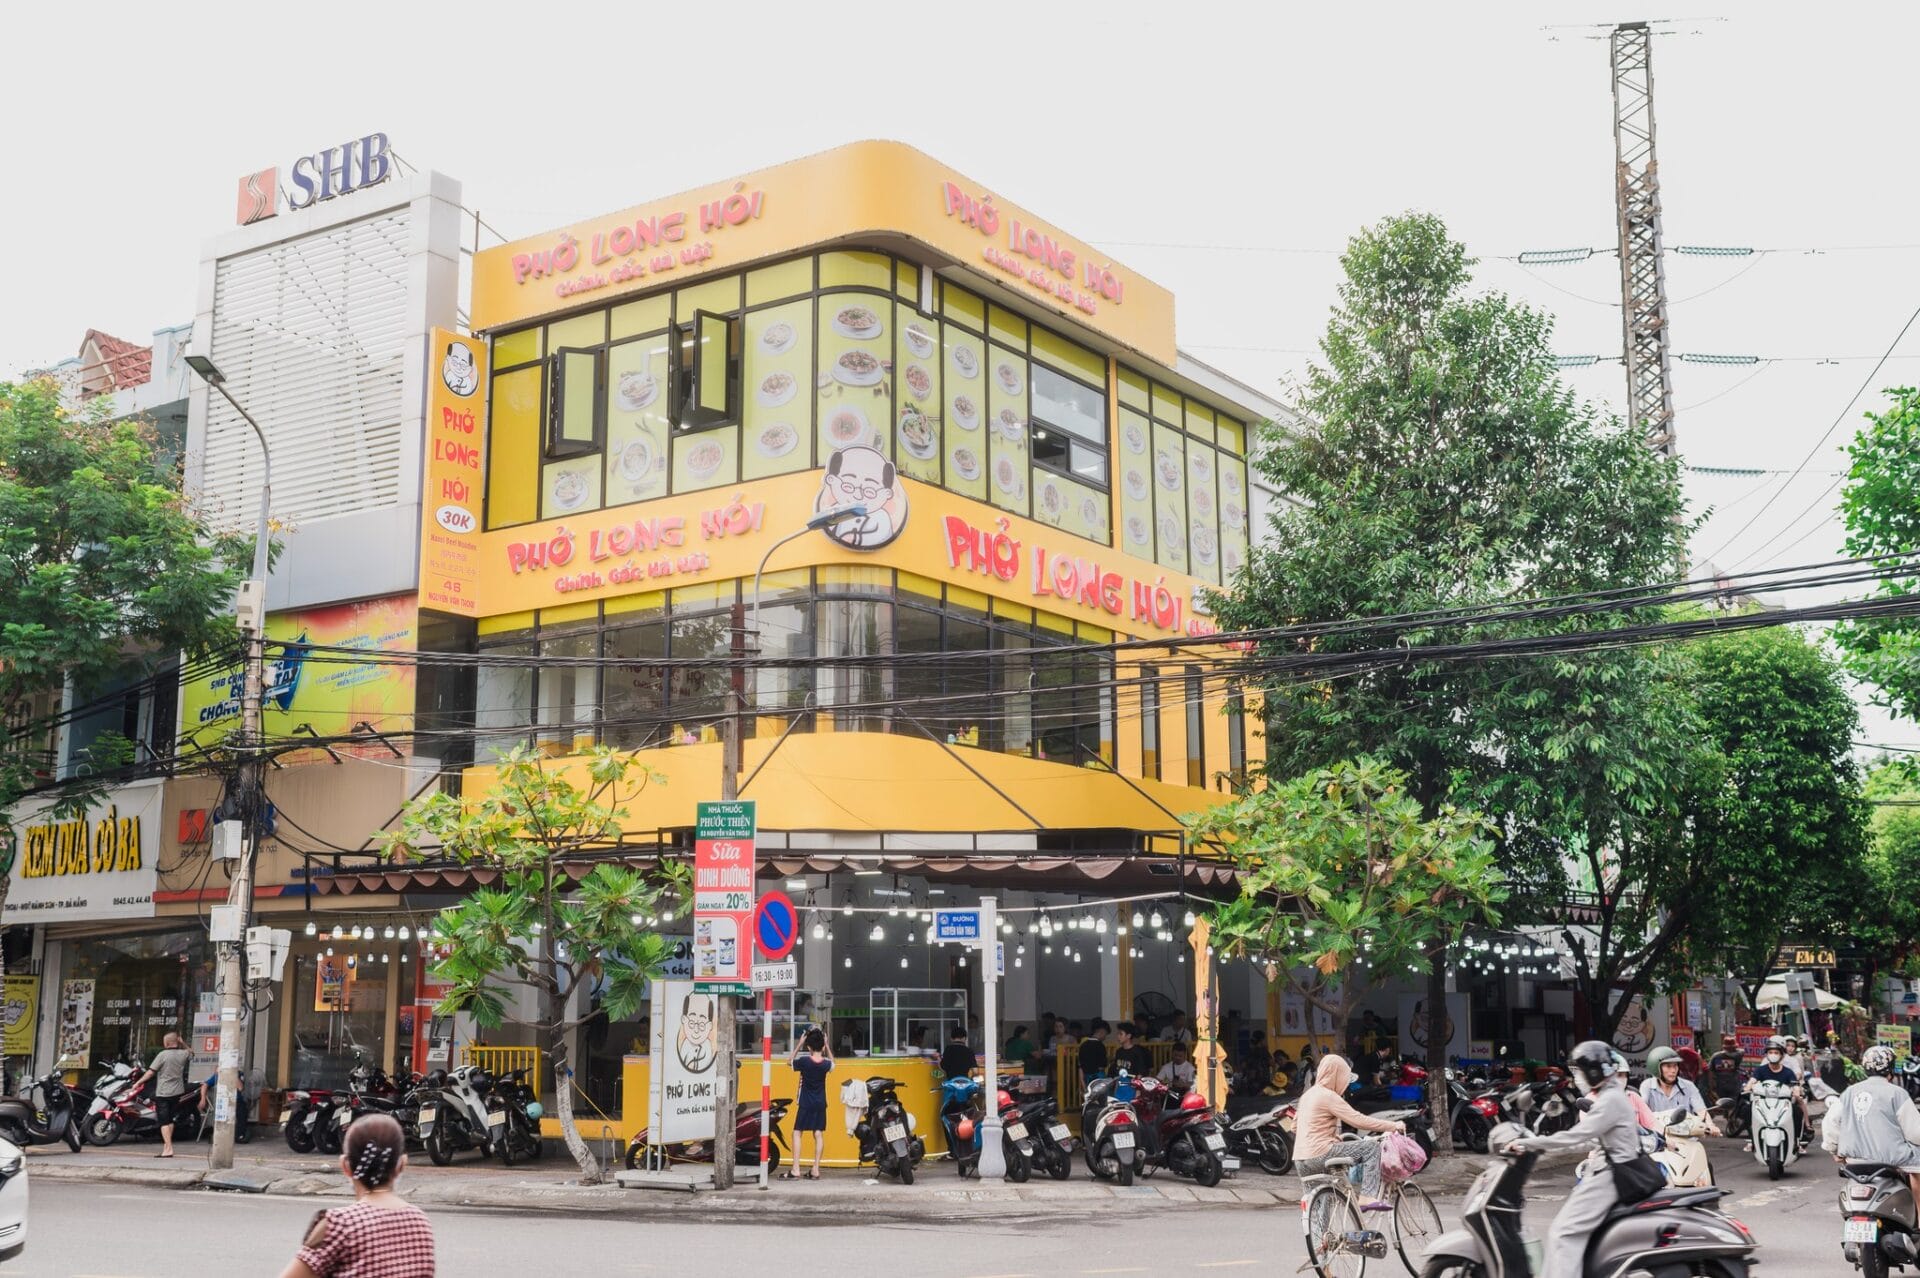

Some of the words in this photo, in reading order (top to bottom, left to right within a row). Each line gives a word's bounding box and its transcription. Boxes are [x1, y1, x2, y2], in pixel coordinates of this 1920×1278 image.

[289, 132, 391, 211] SHB
[943, 181, 999, 237] PHỞ
[1009, 218, 1077, 280] LONG
[512, 232, 578, 285] PHỞ
[591, 211, 687, 266] LONG
[442, 406, 476, 434] PHỞ
[435, 438, 479, 469] LONG
[442, 476, 470, 504] HÓI
[443, 510, 470, 529] 30K
[507, 525, 577, 575] PHỞ
[590, 517, 687, 564] LONG
[942, 515, 1022, 582] PHỞ
[1031, 544, 1124, 616] LONG
[1130, 575, 1183, 633] HÓI
[20, 823, 58, 878] KEM
[93, 804, 117, 873] CÔ
[116, 815, 142, 872] BA
[710, 841, 741, 860] Sữa
[697, 867, 719, 888] DINH
[720, 863, 751, 888] DƯỠNG
[726, 892, 750, 910] 20%
[754, 970, 772, 982] 16:30
[776, 968, 793, 981] 19:00
[1628, 1058, 1647, 1069] ONG
[666, 1079, 685, 1100] PHỞ
[688, 1081, 711, 1100] LONG
